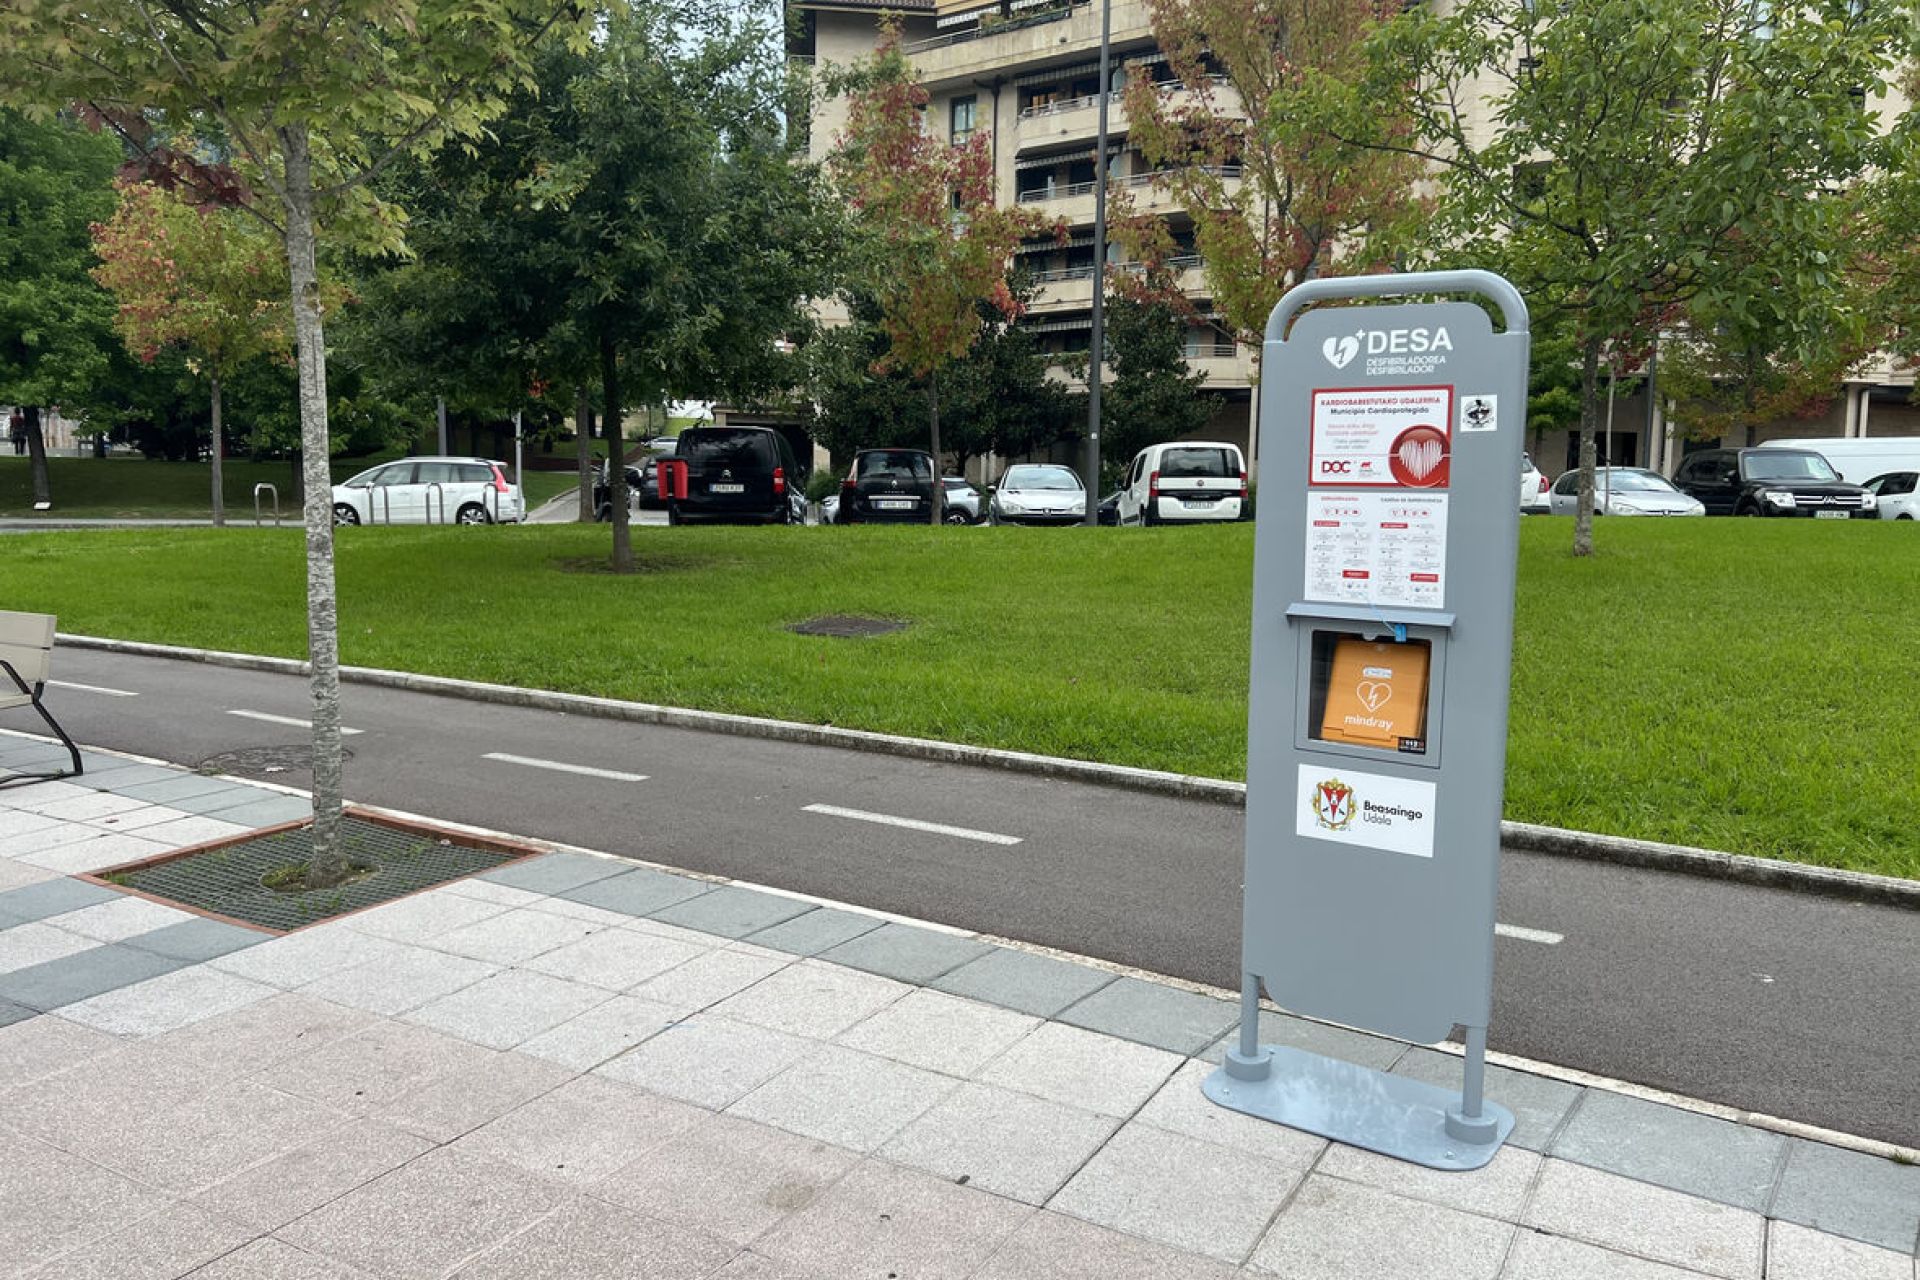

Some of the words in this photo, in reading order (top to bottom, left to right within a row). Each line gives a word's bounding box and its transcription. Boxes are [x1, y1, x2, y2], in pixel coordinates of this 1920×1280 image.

[1367, 327, 1453, 354] DESA
[1330, 407, 1366, 415] Municipio
[1321, 460, 1351, 473] DOC
[1344, 714, 1393, 731] mindray
[1363, 800, 1423, 821] Beasaingo
[1363, 812, 1391, 826] Udala
